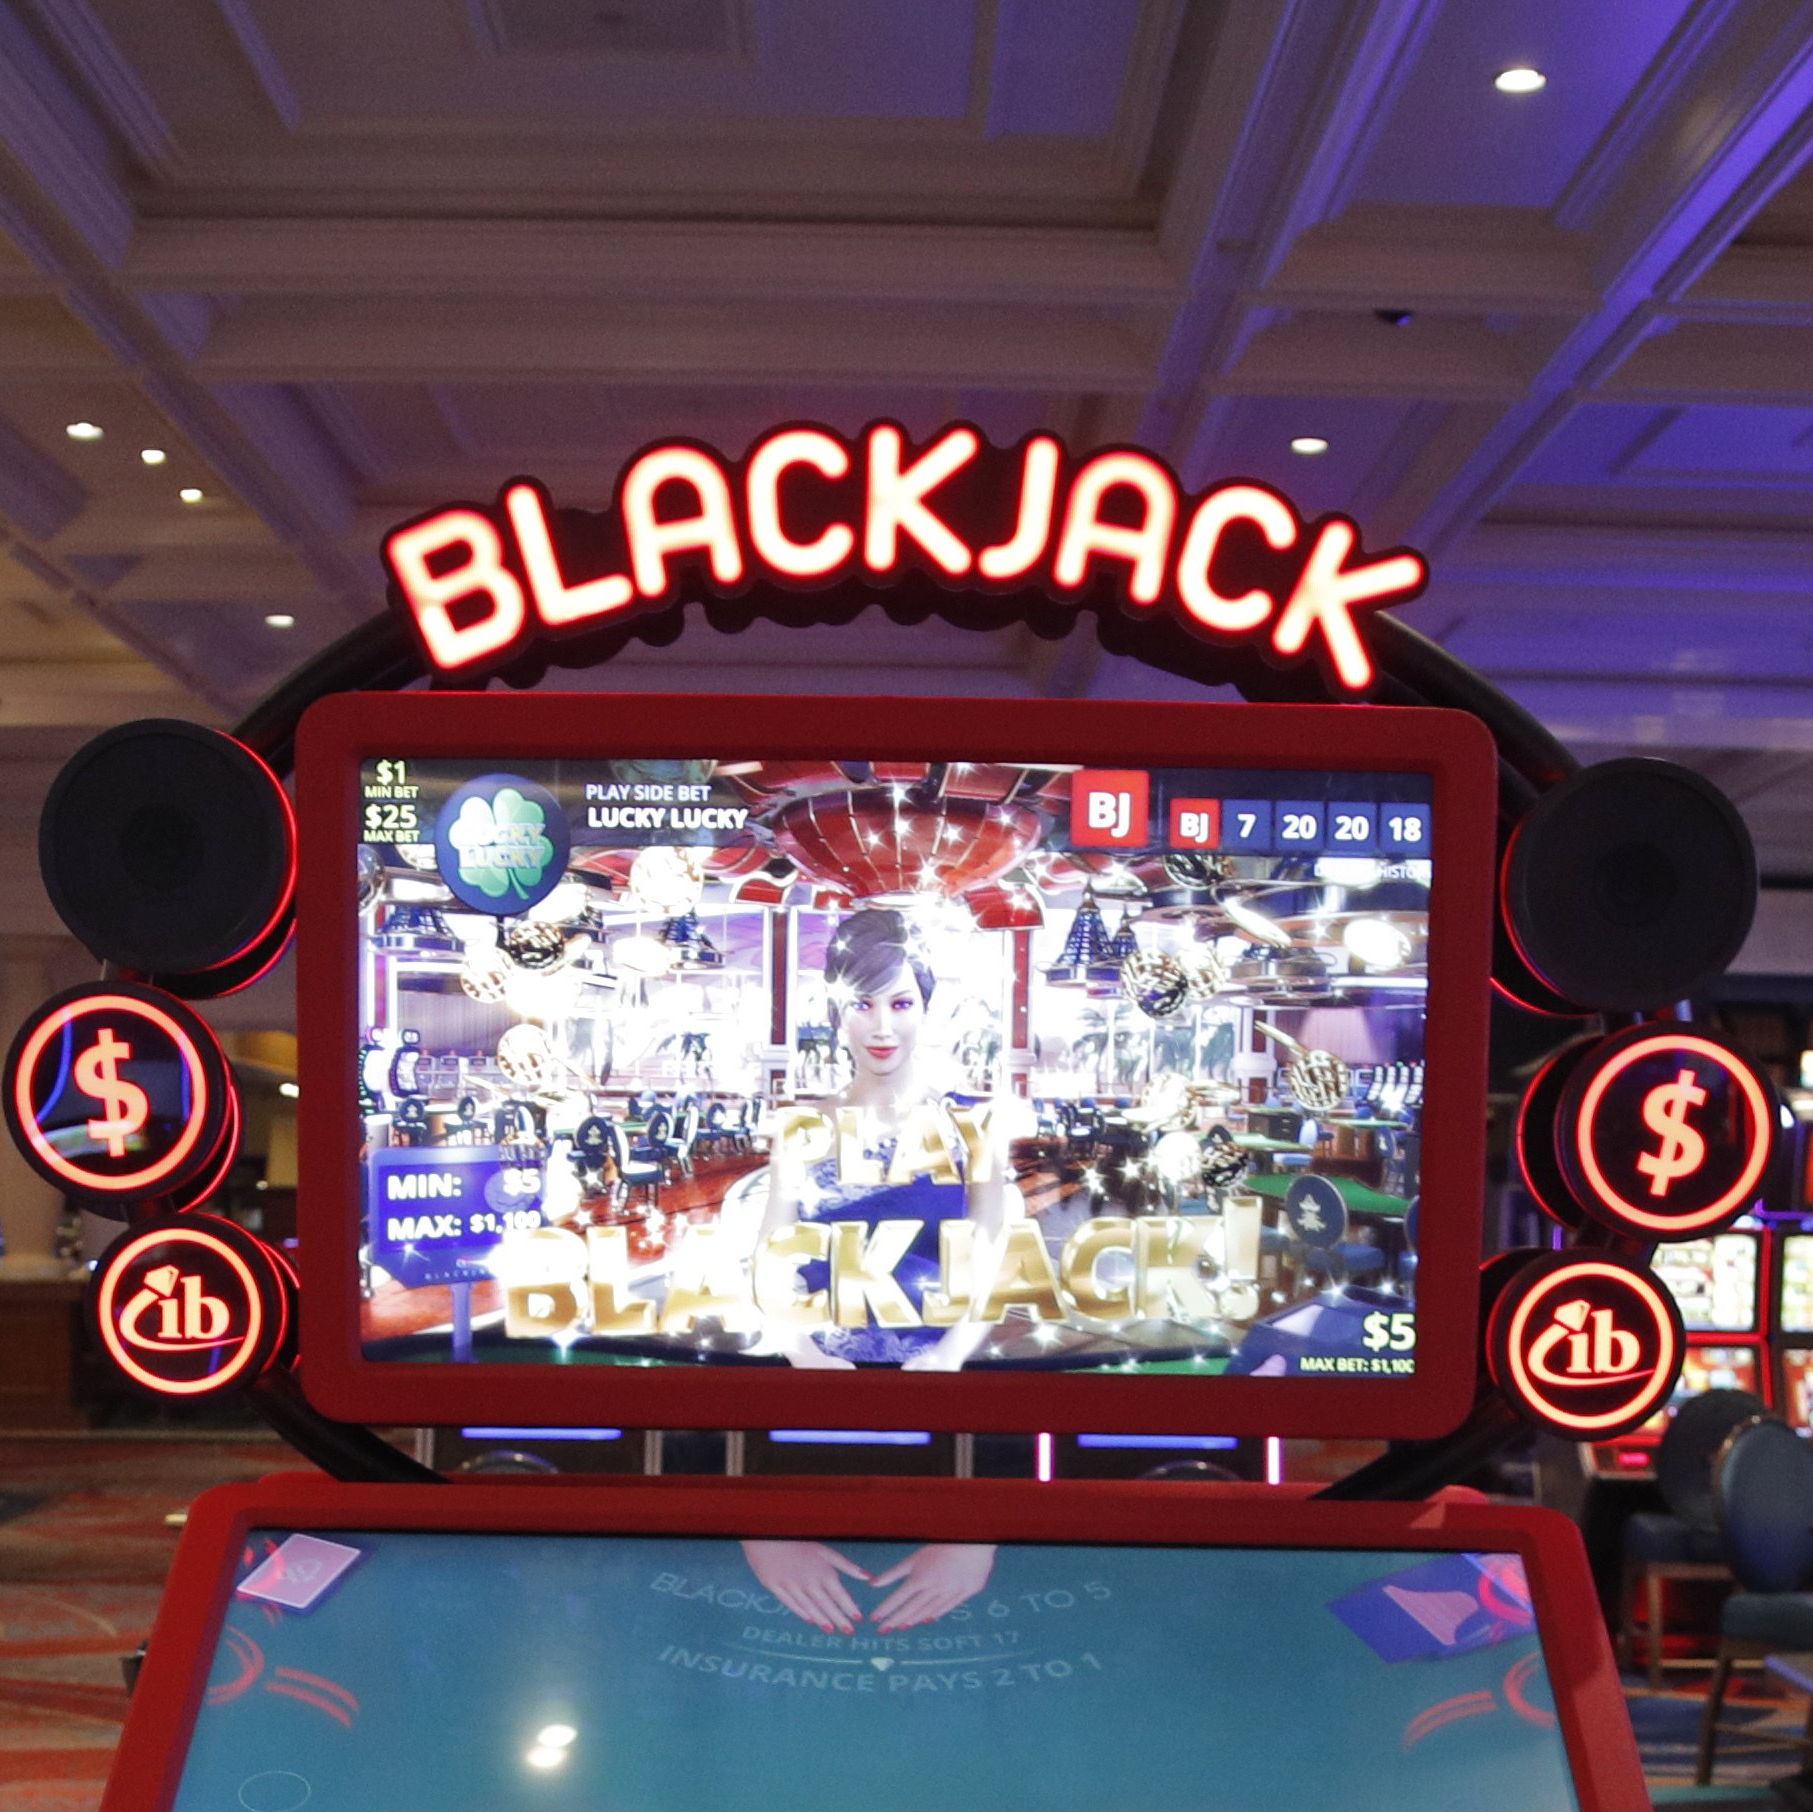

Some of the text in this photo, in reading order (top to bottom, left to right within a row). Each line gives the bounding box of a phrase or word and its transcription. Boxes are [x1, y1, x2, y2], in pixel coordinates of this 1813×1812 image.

[385, 424, 1426, 692] BLACKJACK
[375, 760, 406, 784] $1
[364, 785, 420, 799] MIN BET
[585, 784, 711, 801] PLAY SIDE BET
[364, 804, 417, 830] $25
[588, 807, 749, 829] LUCKY LUCKY
[1088, 792, 1131, 838] BJ
[1179, 812, 1422, 843] BJ 7 20 20 18
[363, 829, 420, 843] MAX BET
[458, 823, 546, 845] CKY
[73, 1027, 150, 1158] $
[780, 1105, 996, 1186] PLAY
[1636, 1069, 1707, 1197] $
[388, 1168, 542, 1201] MIN: $5
[388, 1210, 542, 1241] MAX: $1,100
[505, 1196, 1264, 1338] BLACKJACK!
[157, 1276, 231, 1340] ib
[1362, 1310, 1417, 1353] $5
[1566, 1309, 1642, 1375] ib
[1299, 1356, 1336, 1371] MAX
[1336, 1357, 1369, 1372] BET:
[989, 1599, 1010, 1618] 6
[1022, 1589, 1076, 1614] TO
[1082, 1581, 1112, 1601] 5
[741, 1625, 1020, 1651] DEALER HITS SOFT 17
[658, 1645, 1103, 1692] INSURANCE PAYS 2 TO 1
